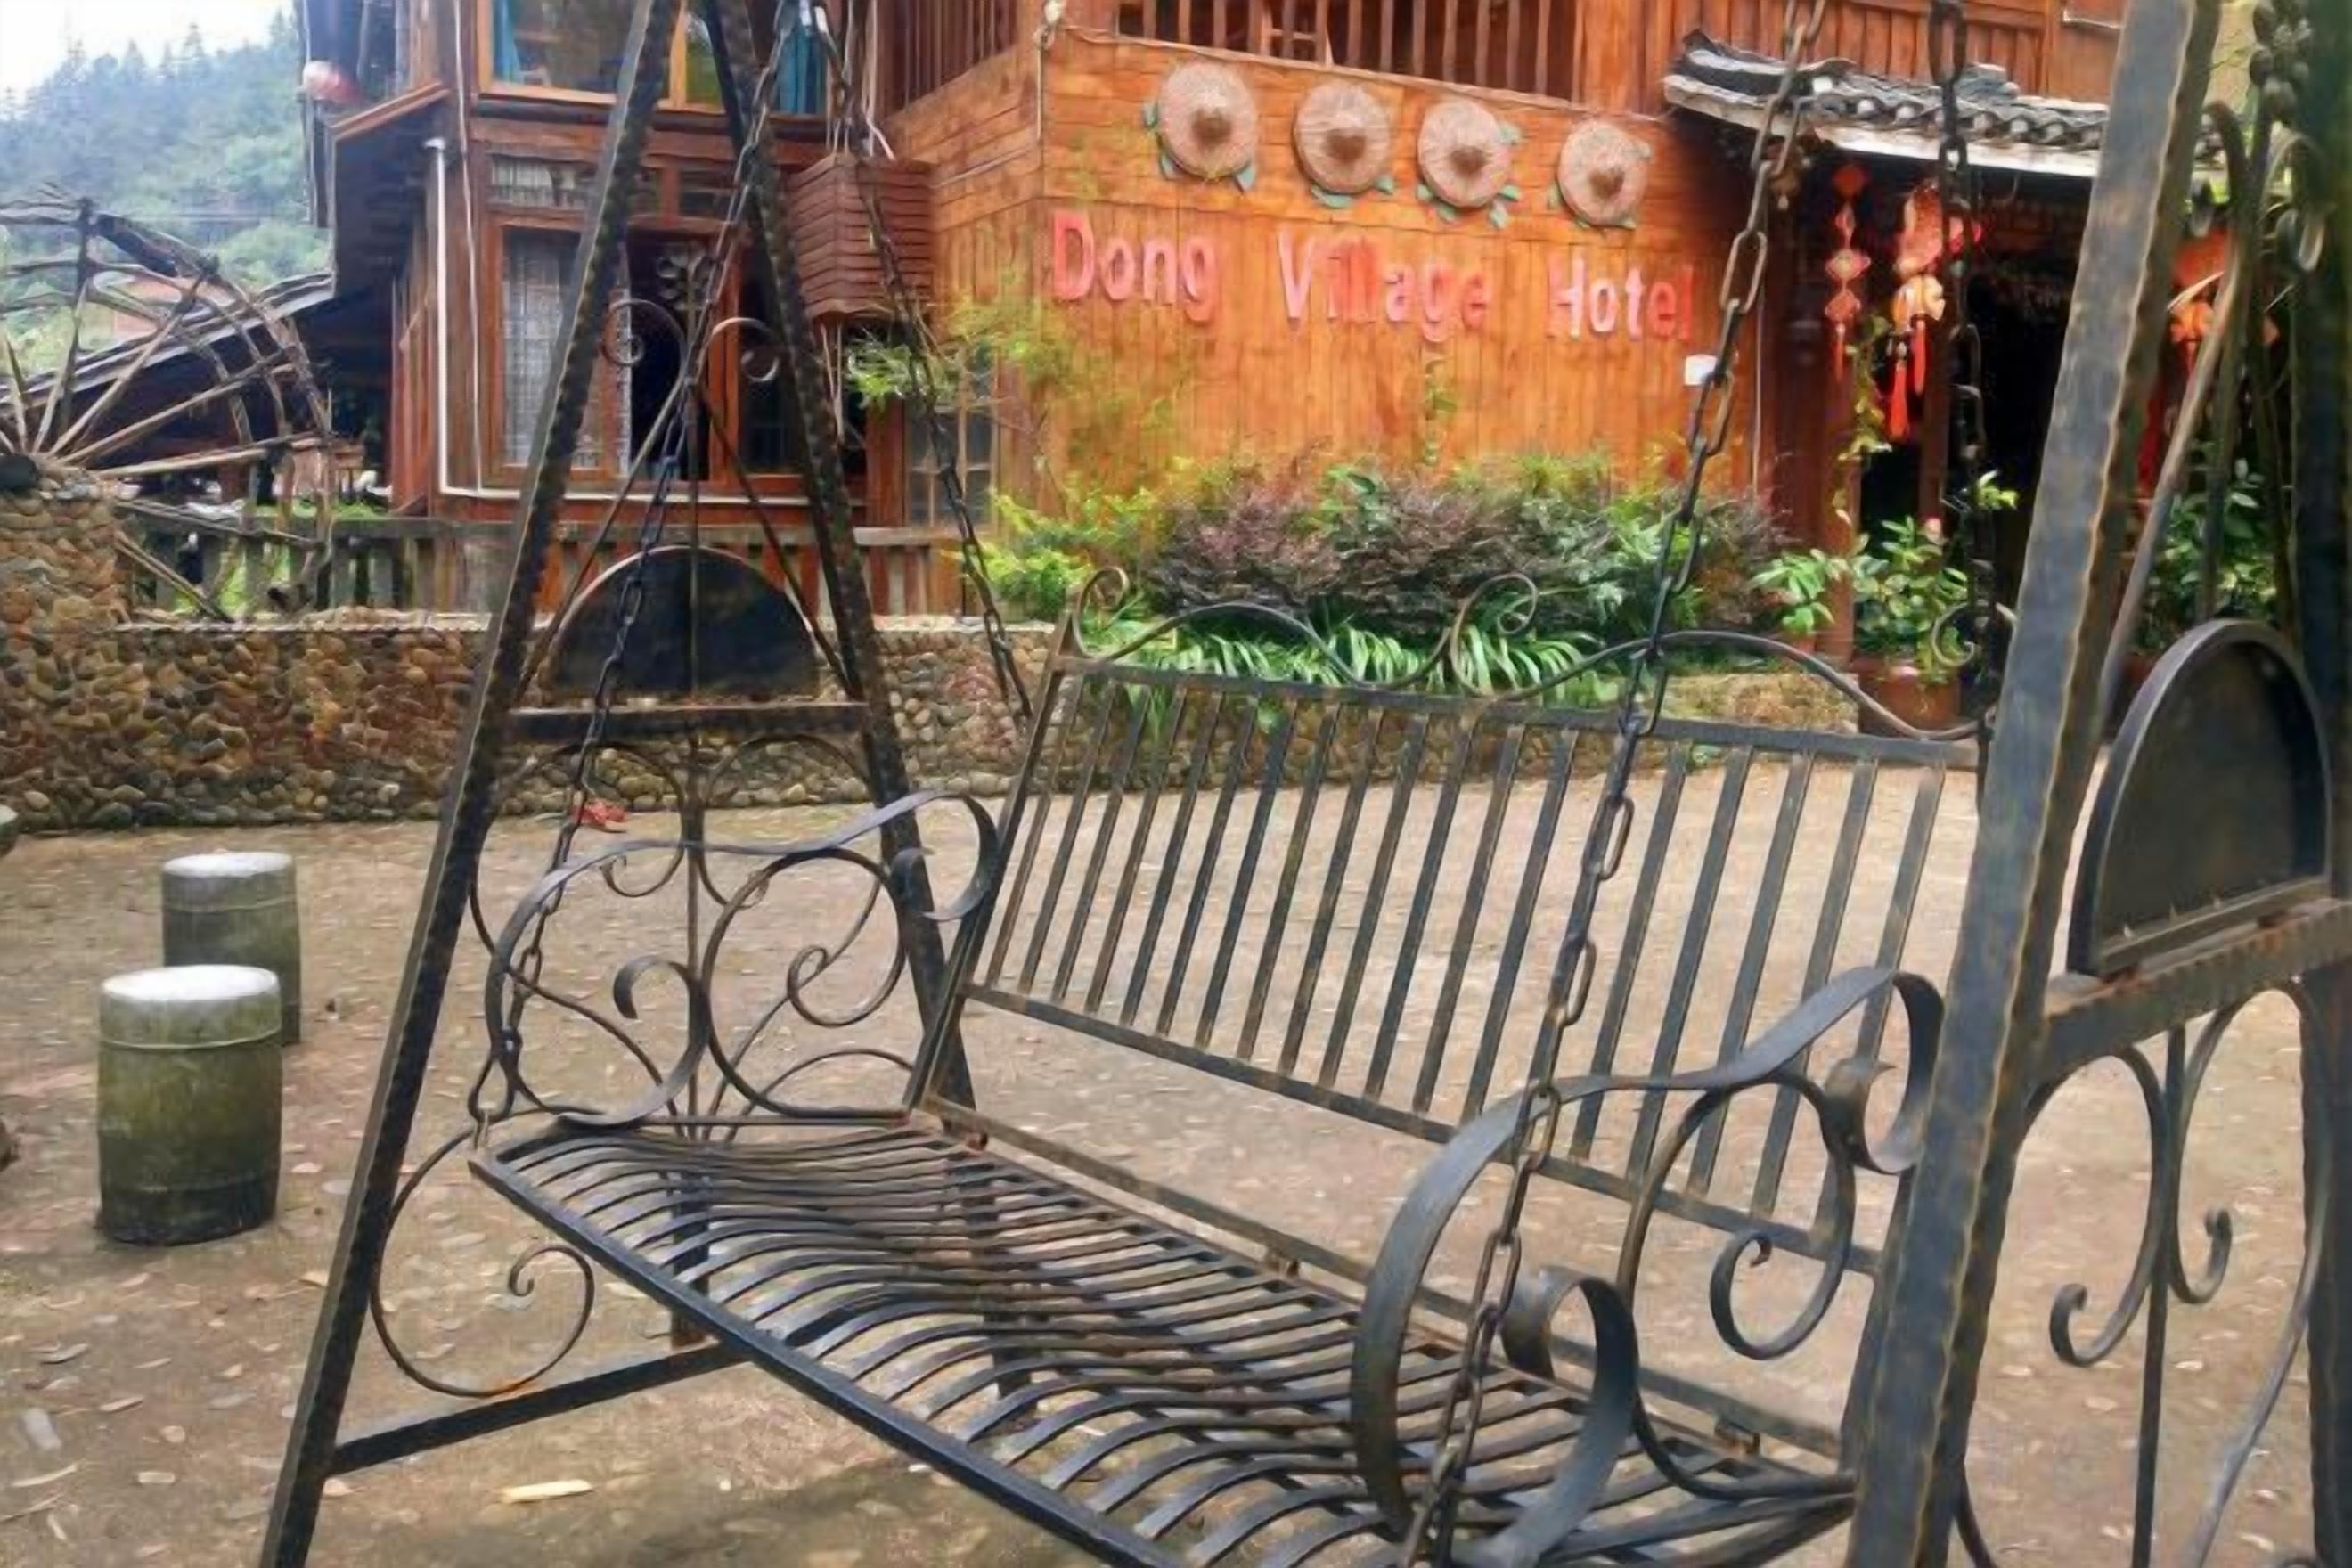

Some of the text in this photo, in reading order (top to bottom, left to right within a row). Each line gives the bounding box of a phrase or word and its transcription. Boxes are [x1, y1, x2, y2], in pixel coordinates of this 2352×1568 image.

[1053, 211, 1695, 343] Dong Village Hotel
